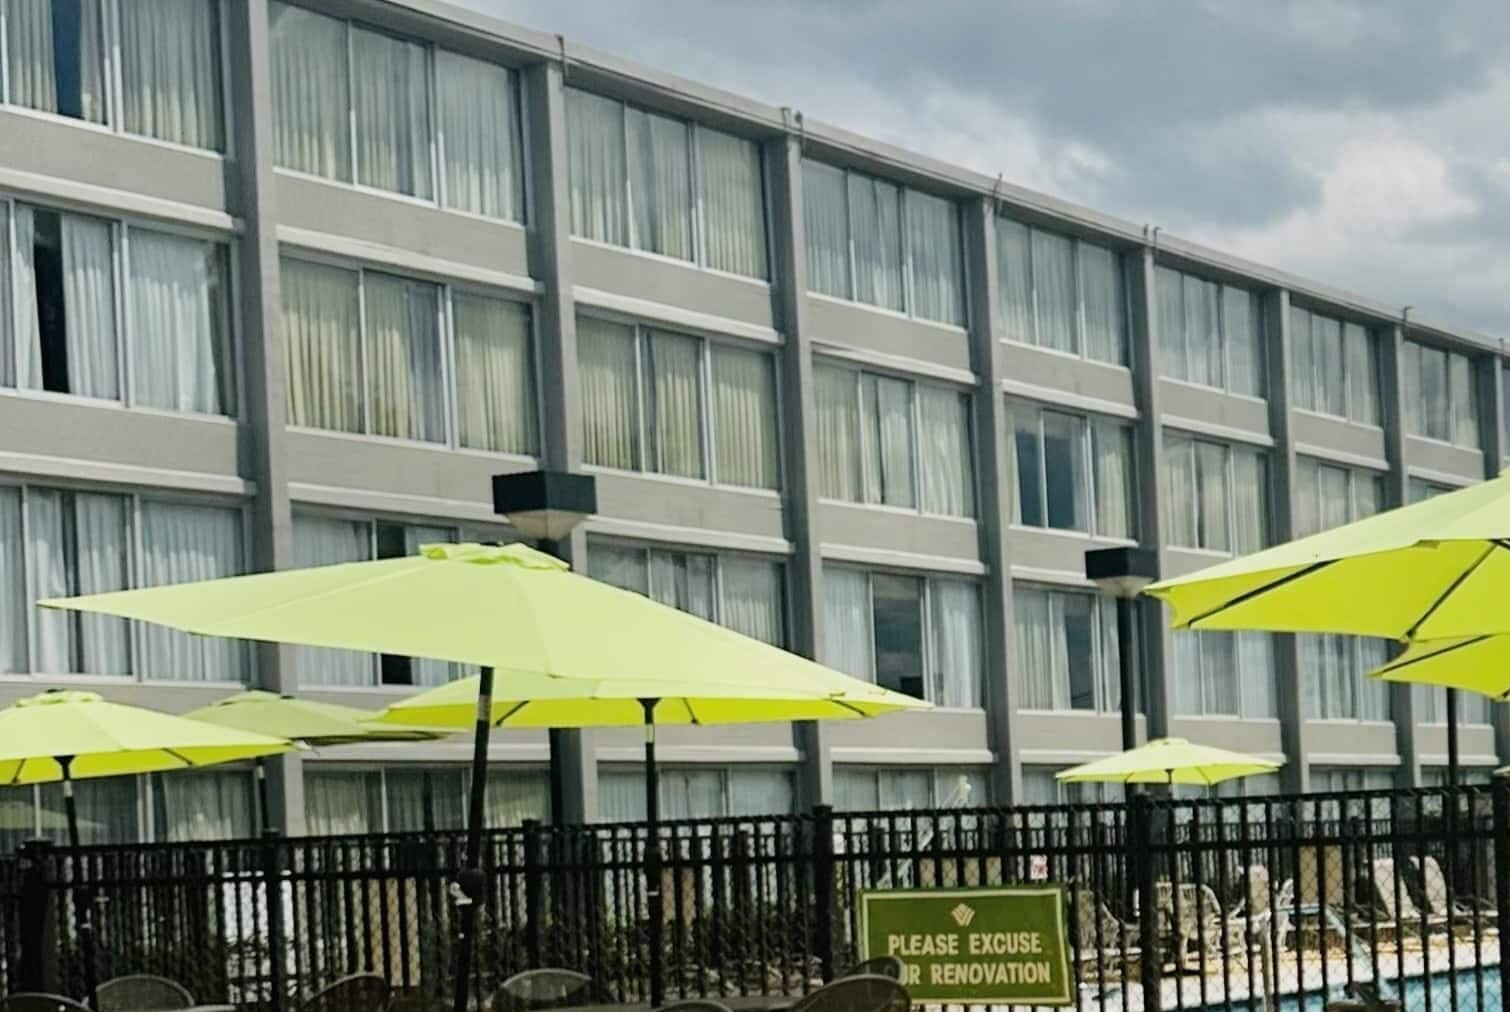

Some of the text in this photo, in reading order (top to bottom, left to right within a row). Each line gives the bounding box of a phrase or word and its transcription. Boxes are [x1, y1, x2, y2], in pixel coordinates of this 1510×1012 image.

[888, 932, 1042, 956] PLEASE EXCUSE
[930, 962, 1051, 985] RENOVATION
